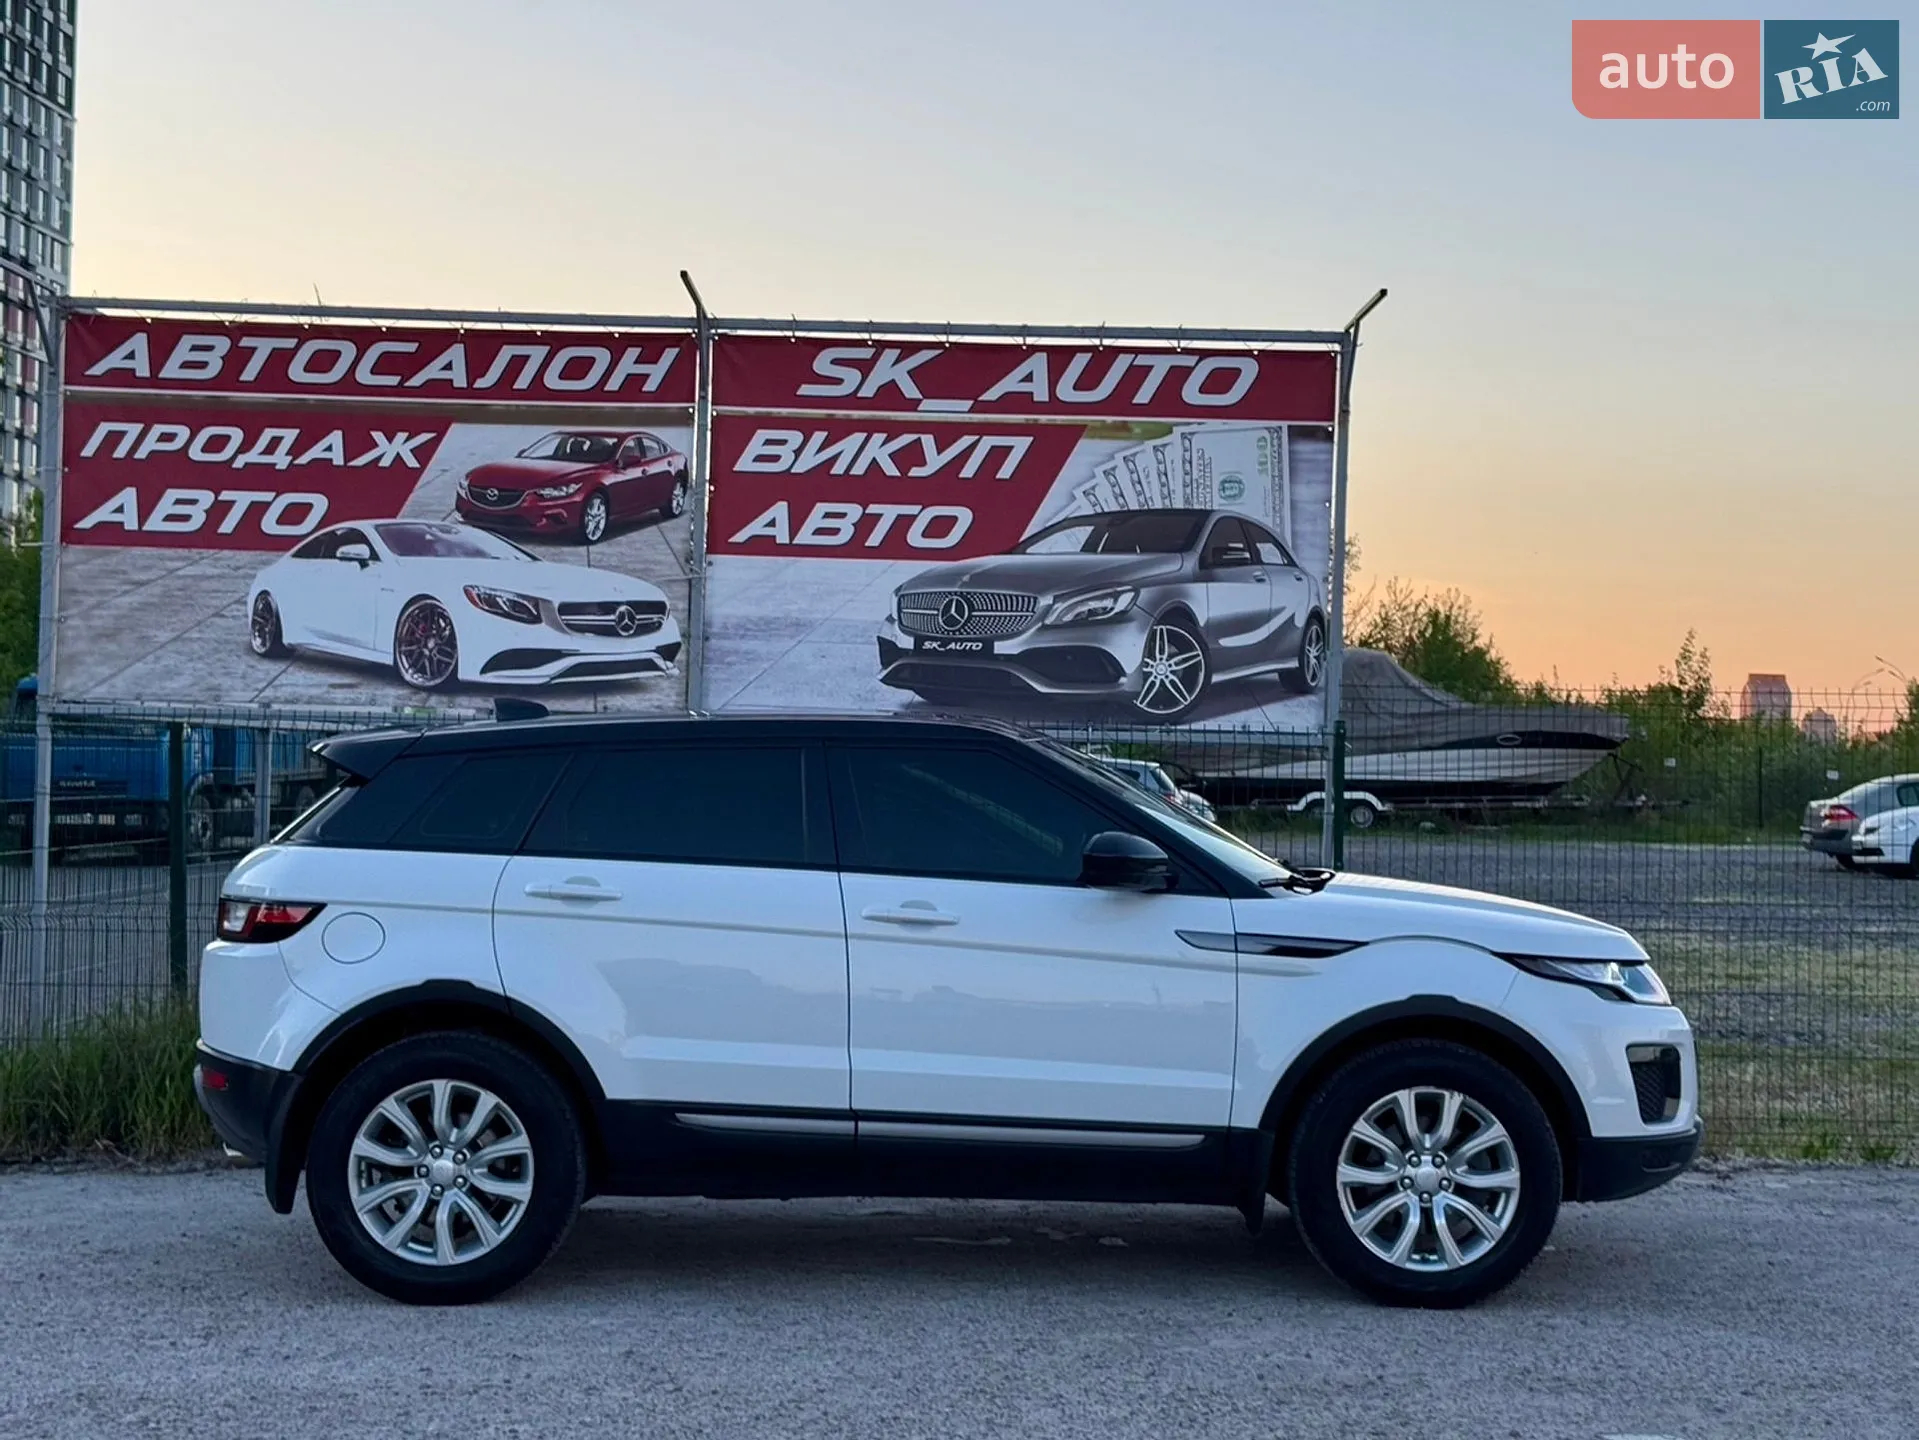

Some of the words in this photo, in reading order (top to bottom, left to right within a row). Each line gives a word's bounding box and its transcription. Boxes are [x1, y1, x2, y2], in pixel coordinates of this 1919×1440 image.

[85, 332, 680, 392] АВТОСАЛОН
[795, 346, 1260, 413] SK_AUTO
[80, 421, 437, 470] ПРОДАЖ
[733, 428, 1034, 480] ВИКУП
[74, 486, 330, 536] АВТО
[728, 500, 974, 549] АВТО
[921, 640, 984, 651] SK_AUTO
